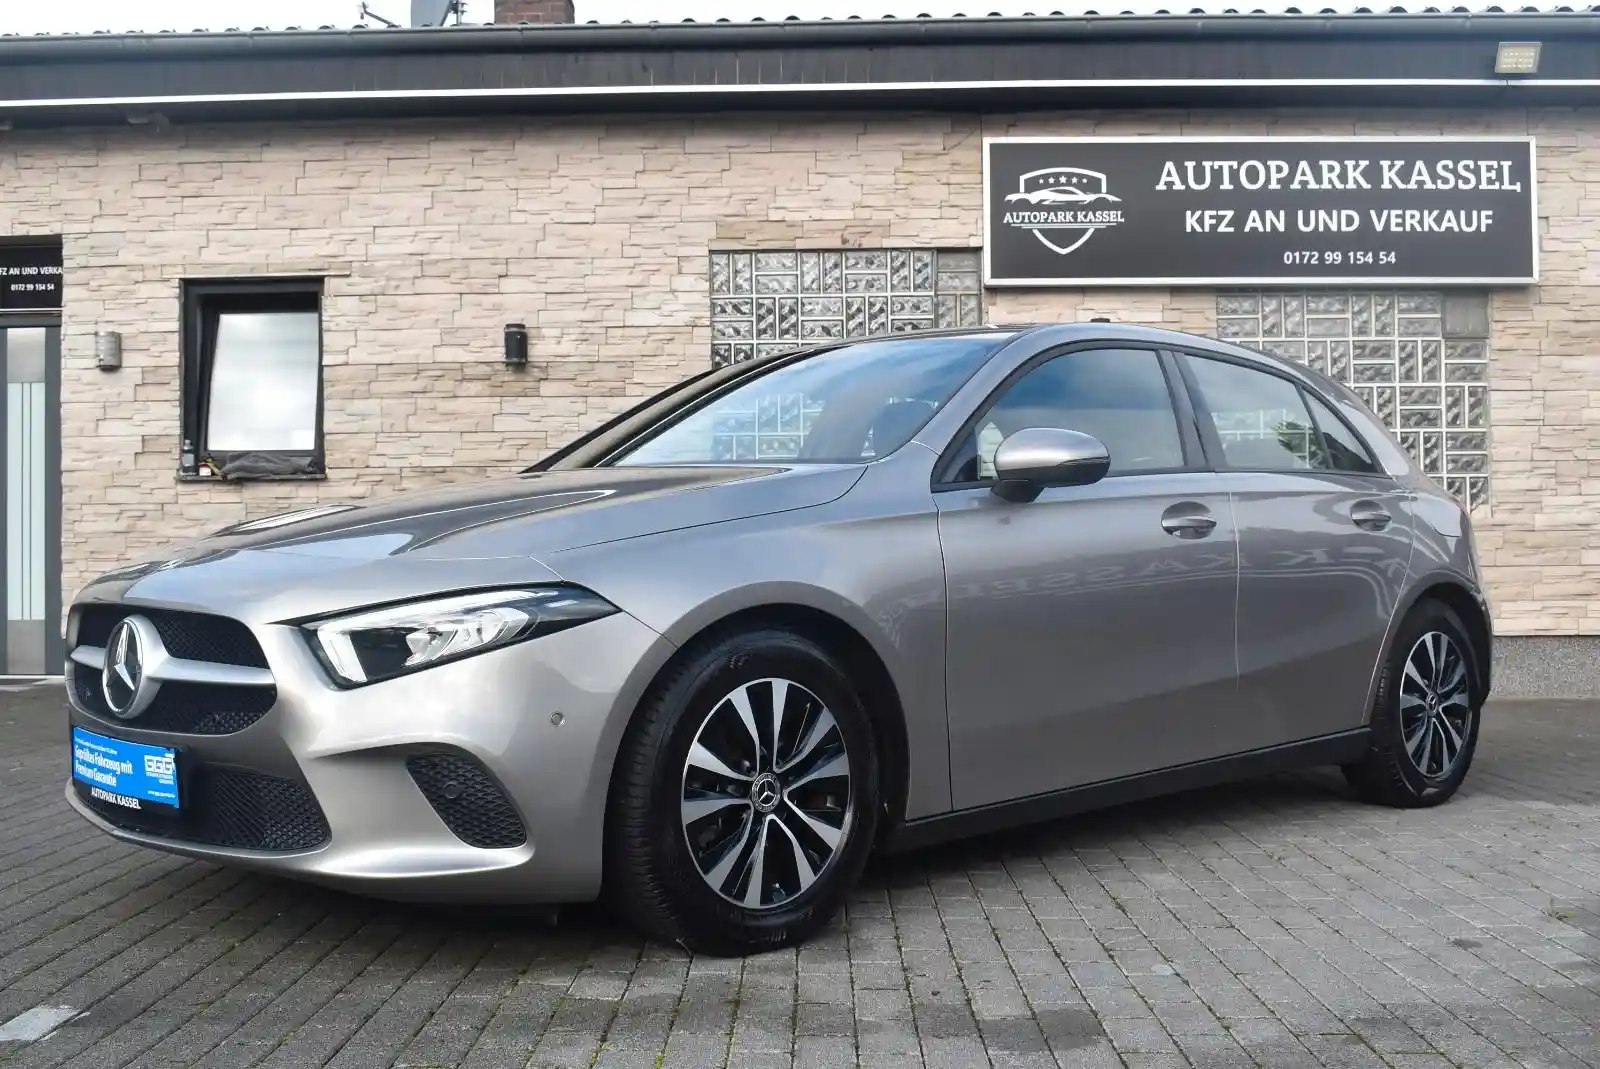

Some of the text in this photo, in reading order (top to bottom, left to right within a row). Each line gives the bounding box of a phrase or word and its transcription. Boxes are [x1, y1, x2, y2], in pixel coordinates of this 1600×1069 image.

[1155, 160, 1522, 192] AUTOPARK KASSEL
[1003, 210, 1125, 224] AUTOPARK KASSEL
[1185, 208, 1494, 233] KFZ AN UND VERKAUF
[1283, 250, 1397, 265] 0172 99 154 54
[9, 267, 20, 275] AN
[22, 267, 38, 275] UND
[11, 283, 55, 291] 0172 99 154 54
[95, 752, 121, 774] Fahrzeug
[120, 760, 133, 774] mit
[91, 786, 142, 809] AUTOPARK KASSEL
